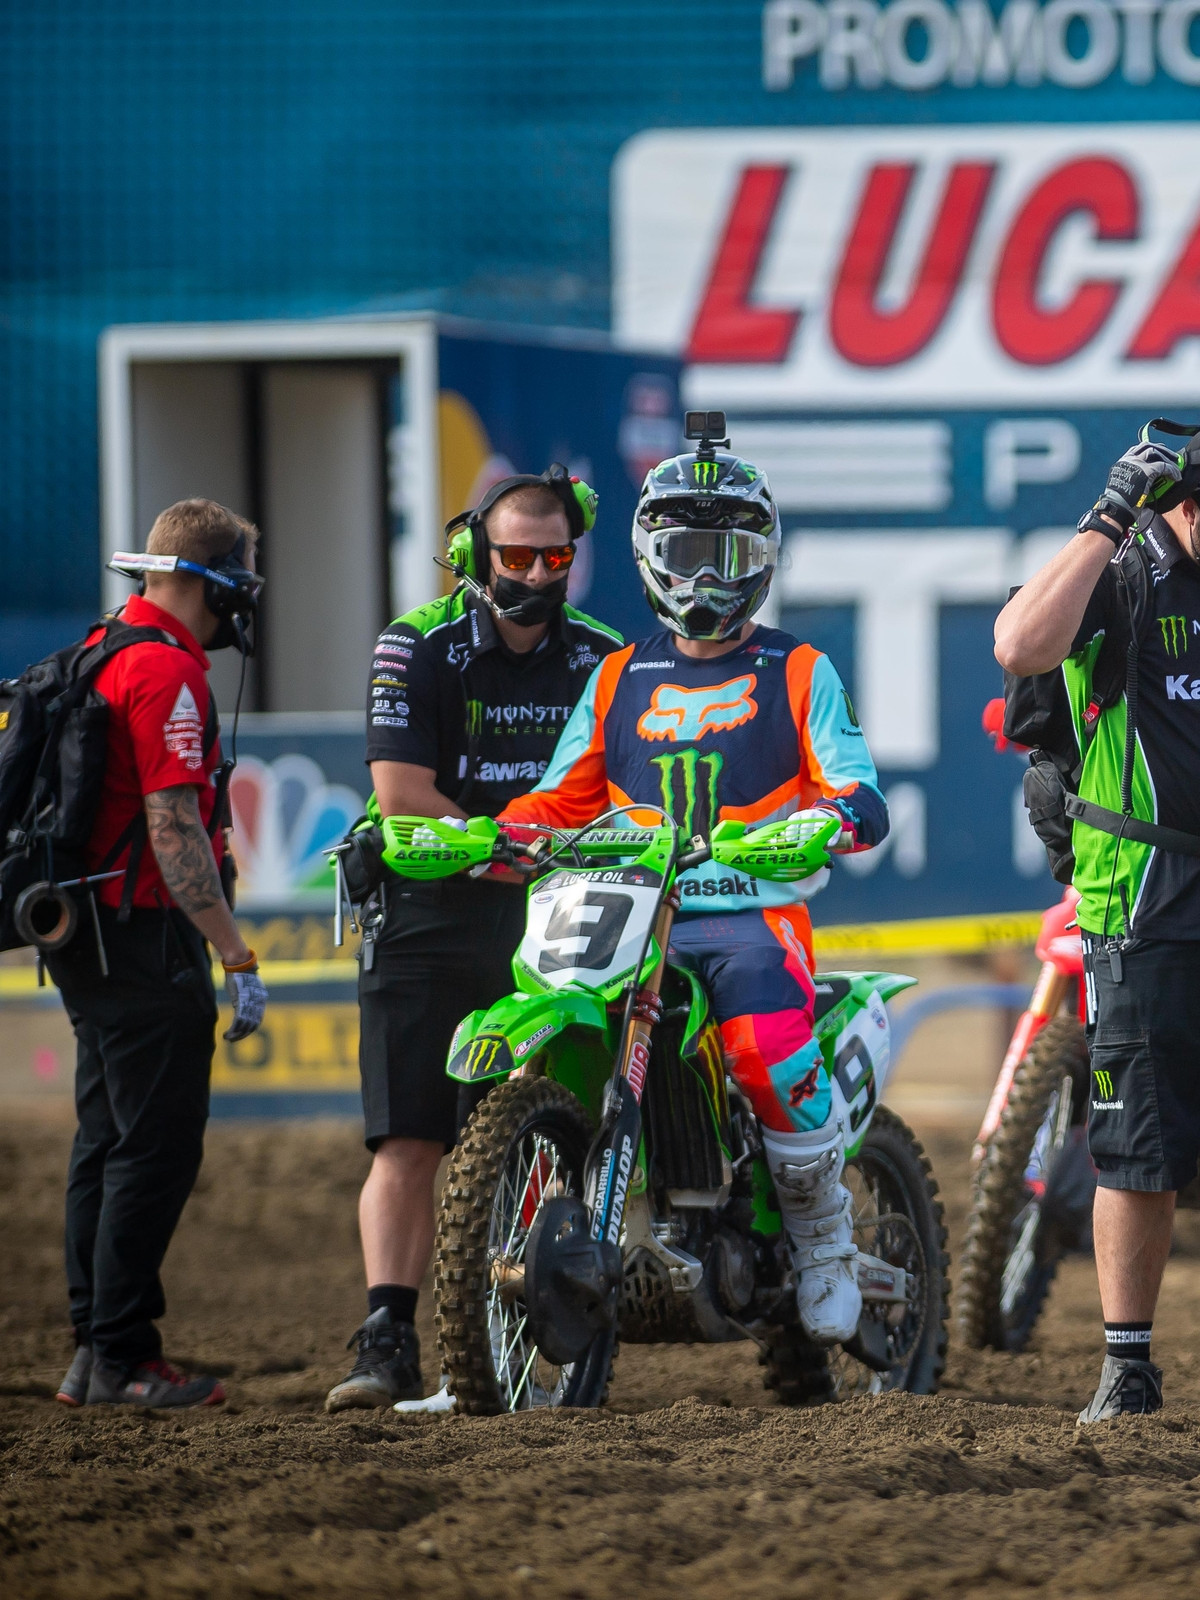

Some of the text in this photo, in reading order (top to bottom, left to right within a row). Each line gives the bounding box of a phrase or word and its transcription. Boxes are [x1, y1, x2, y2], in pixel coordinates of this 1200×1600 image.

[1145, 527, 1167, 560] Kawasaki
[469, 608, 480, 647] Kawasaki
[569, 653, 600, 671] GREEN
[629, 660, 675, 673] Kawasaki
[394, 850, 471, 861] ACERBIS
[730, 852, 808, 866] ACERBIS
[563, 871, 625, 886] LUCAS OIL
[678, 874, 760, 897] asaki
[538, 890, 635, 974] 9
[523, 963, 551, 990] Kawasaki
[525, 1023, 552, 1047] MAXIMA
[833, 1033, 877, 1133] 9
[1092, 1100, 1124, 1110] Kawasaki
[596, 1147, 613, 1210] CARRILLO
[607, 1134, 635, 1248] DUNLOP
